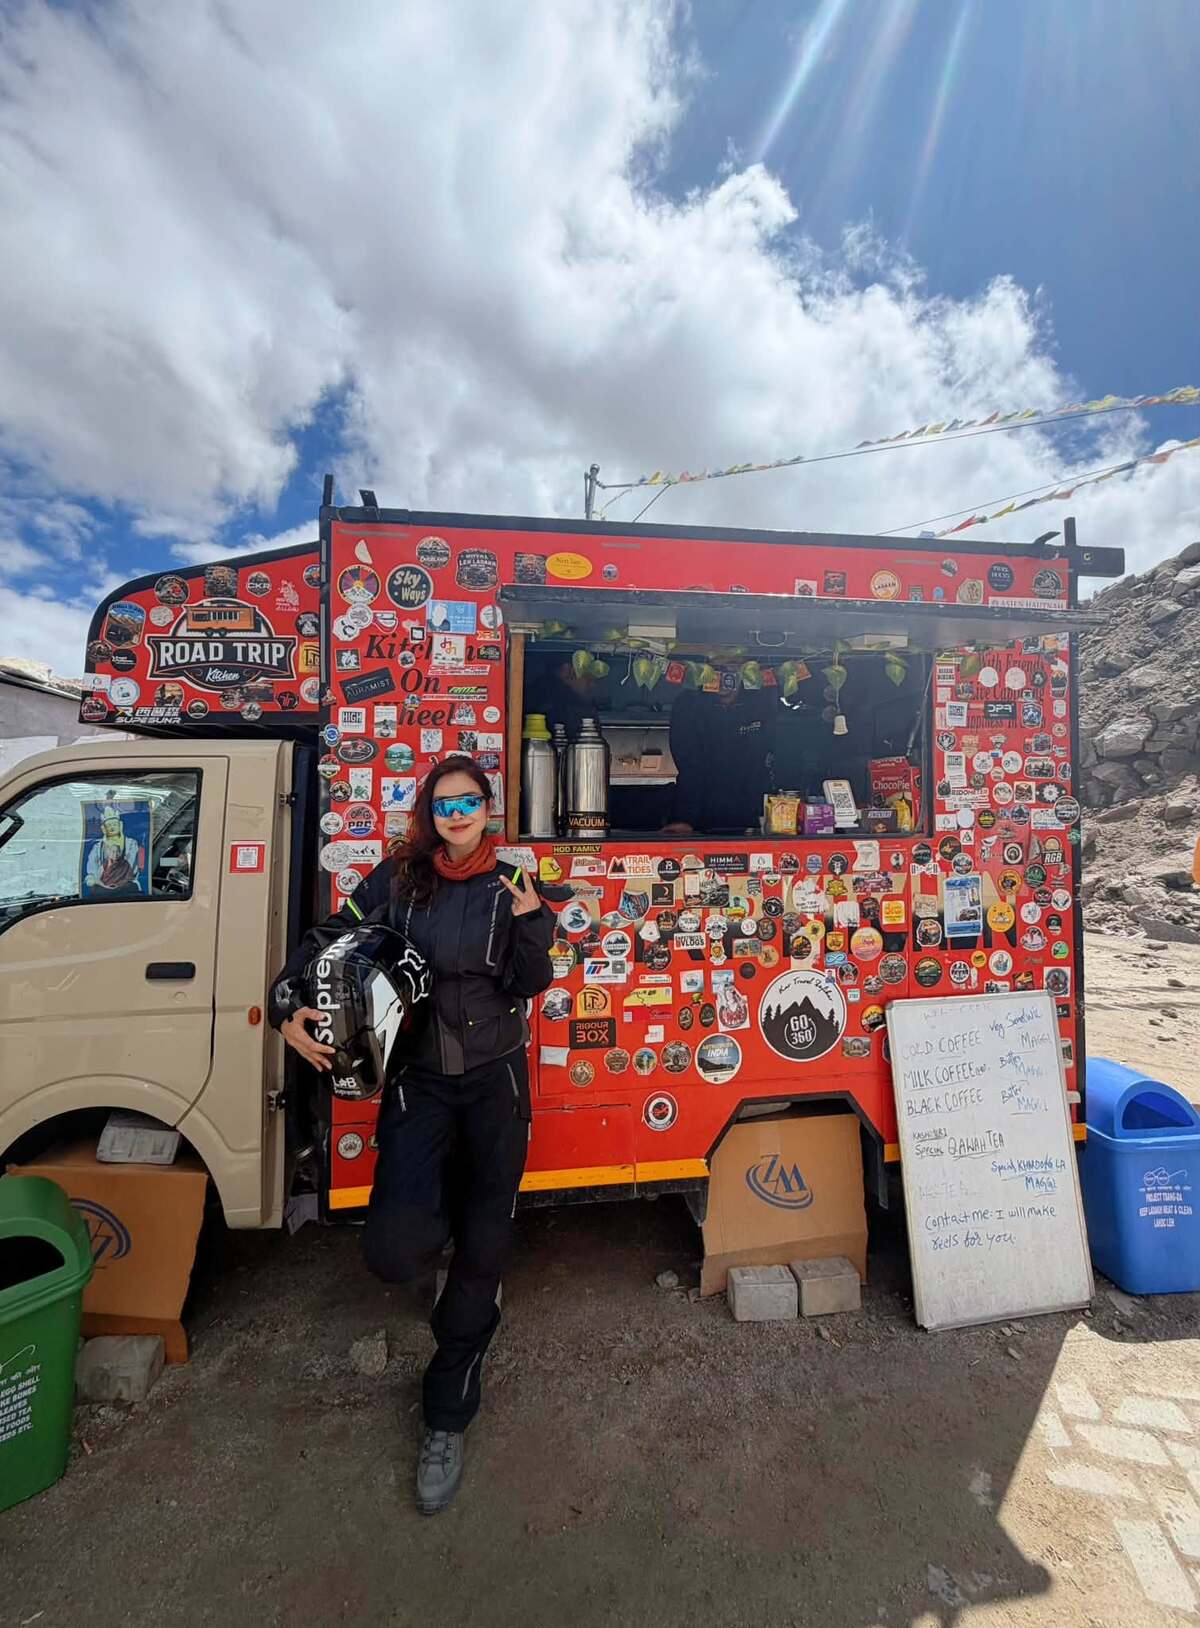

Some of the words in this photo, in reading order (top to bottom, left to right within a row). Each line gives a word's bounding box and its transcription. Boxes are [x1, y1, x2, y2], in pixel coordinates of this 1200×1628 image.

[394, 571, 421, 590] Sky
[402, 588, 426, 604] Ways
[159, 641, 224, 667] ROAD
[232, 642, 285, 666] TRIP
[205, 667, 240, 682] Kitchen
[401, 668, 441, 693] On
[342, 711, 363, 723] HIGH
[569, 817, 605, 827] VACUUM
[573, 845, 601, 853] FAMILY
[1044, 852, 1062, 863] RGB
[316, 932, 358, 1047] supreme
[939, 1030, 982, 1053] COFFEE
[903, 1068, 934, 1089] MILK
[935, 1061, 976, 1084] COFFEE
[906, 1096, 942, 1116] BLACK
[944, 1088, 984, 1112] COFFEE
[986, 1129, 1005, 1149] TEA
[17, 1375, 40, 1391] SHELL
[13, 1385, 37, 1402] BONES
[18, 1406, 33, 1417] TEA
[6, 1415, 31, 1431] FOODS
